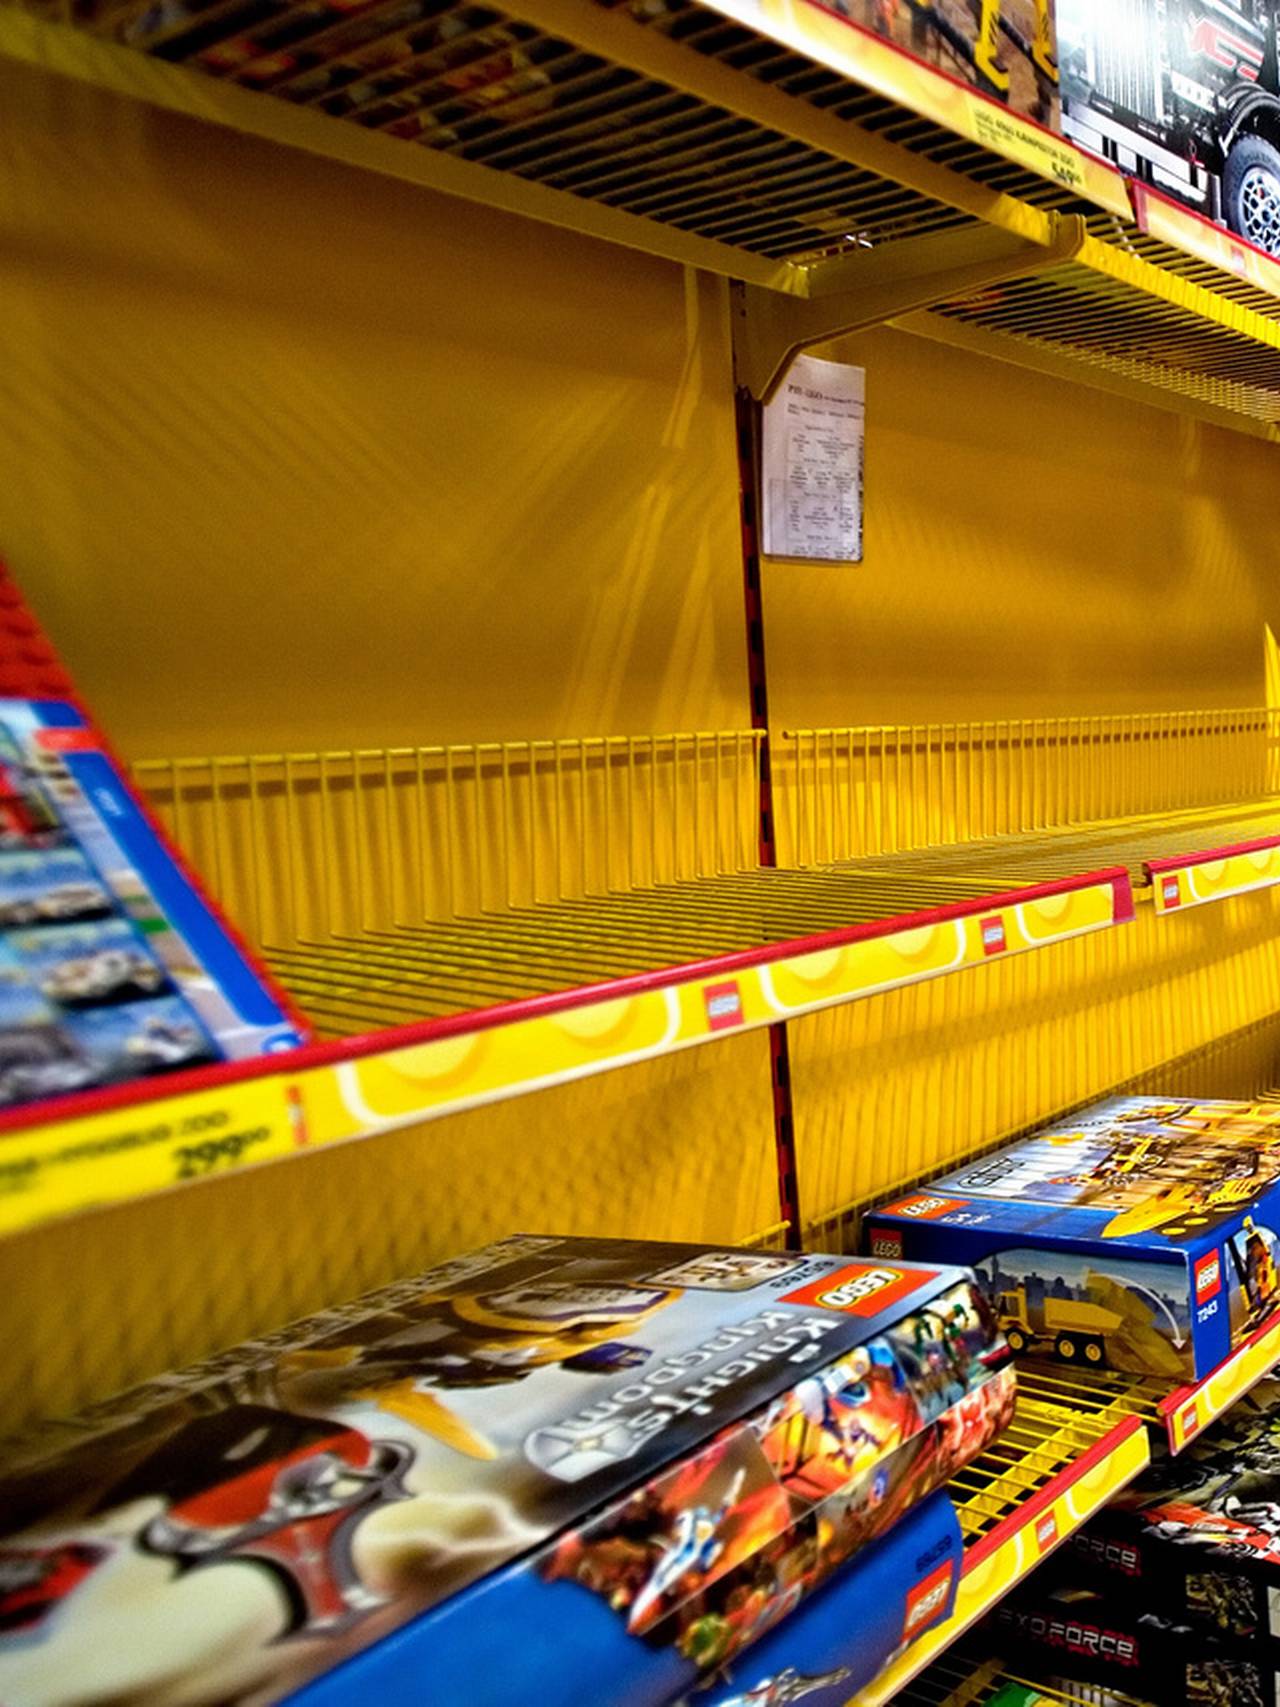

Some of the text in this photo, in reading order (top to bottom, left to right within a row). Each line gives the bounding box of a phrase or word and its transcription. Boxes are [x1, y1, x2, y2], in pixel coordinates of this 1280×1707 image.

[873, 1231, 902, 1258] LEGO
[817, 1268, 902, 1309] LEGO
[1197, 1259, 1220, 1294] LEGO
